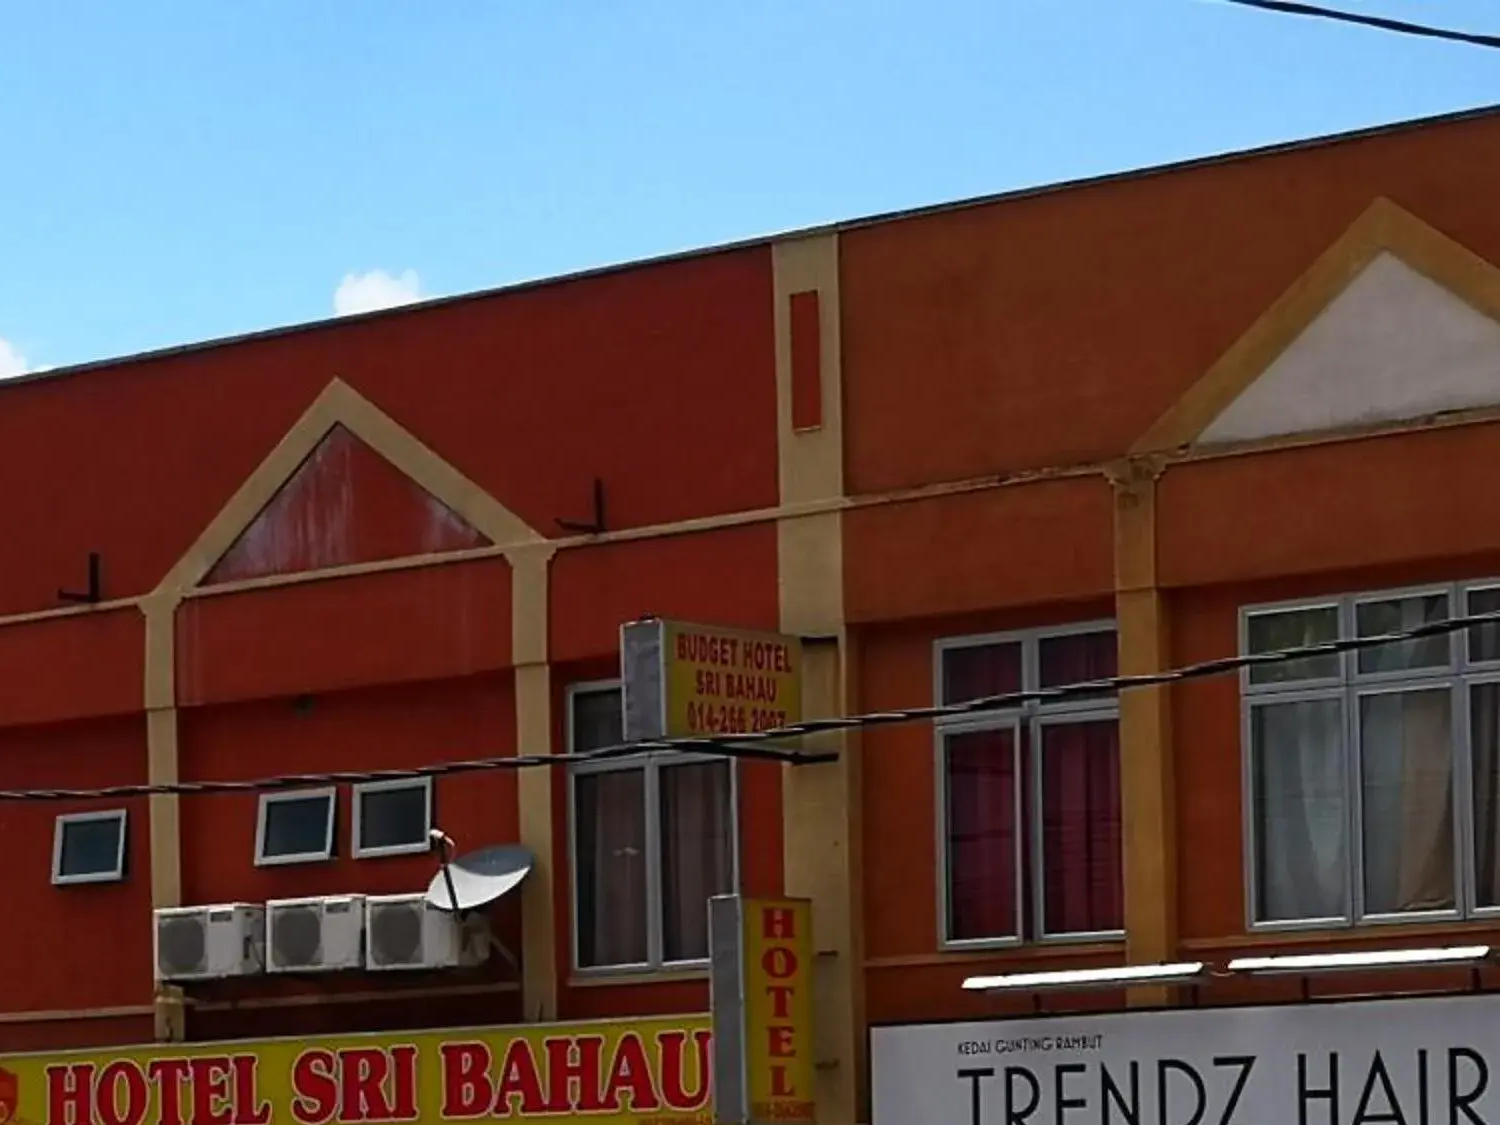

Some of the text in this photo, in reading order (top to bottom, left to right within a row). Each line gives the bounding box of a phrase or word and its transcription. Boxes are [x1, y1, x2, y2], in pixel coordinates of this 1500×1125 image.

[677, 632, 793, 674] BUDGET HOTEL
[695, 670, 777, 704] SRI BAHAU
[762, 908, 797, 1096] HOTEL
[957, 1034, 1103, 1055] KEDAI GUNTING RAMBUT
[441, 1028, 713, 1118] BAHAU
